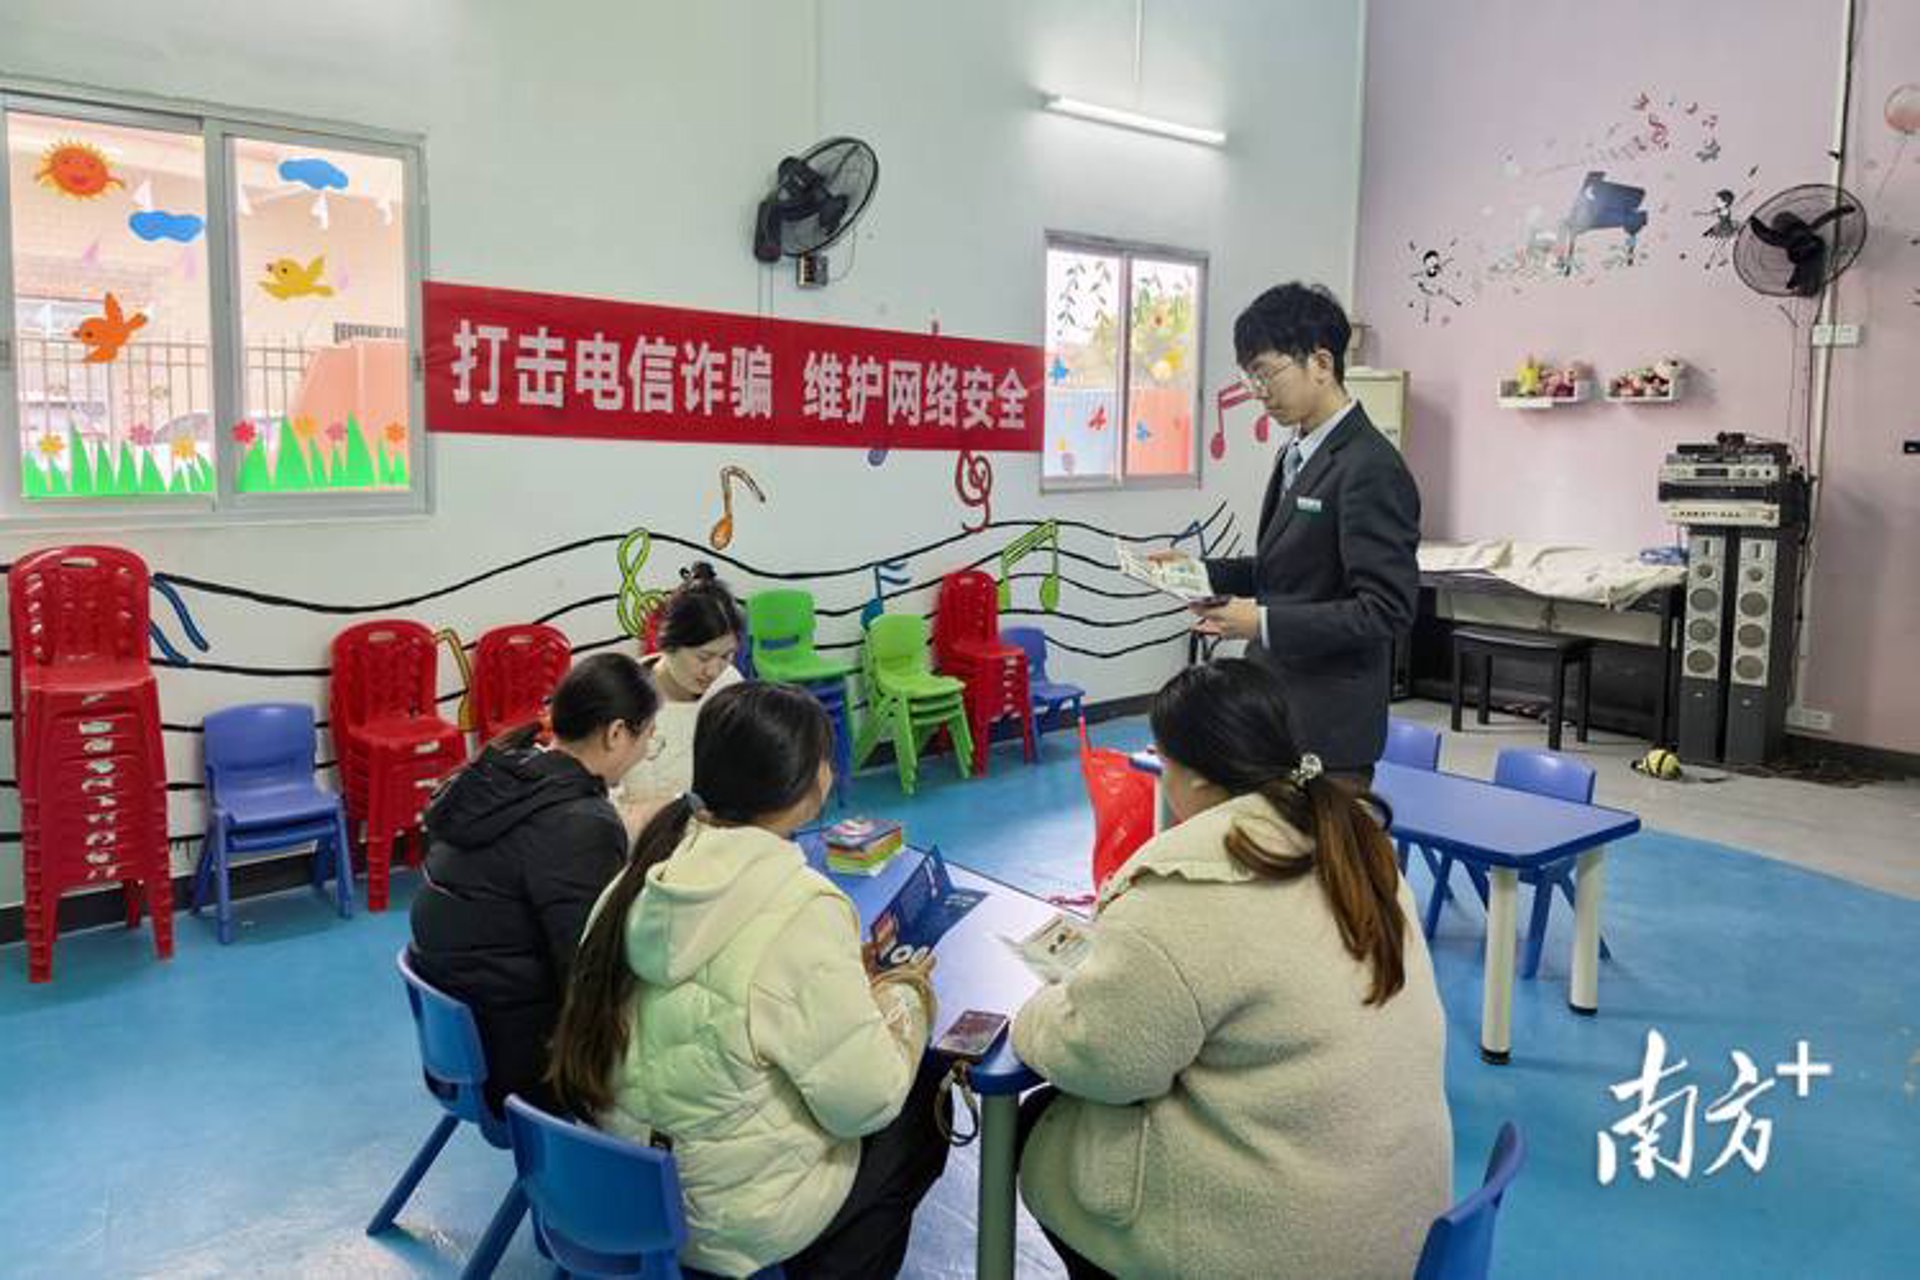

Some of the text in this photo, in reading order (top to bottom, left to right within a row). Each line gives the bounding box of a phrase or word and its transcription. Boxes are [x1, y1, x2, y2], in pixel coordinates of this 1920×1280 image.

[452, 319, 1029, 430] 打击电信诈骗 维护网络安全
